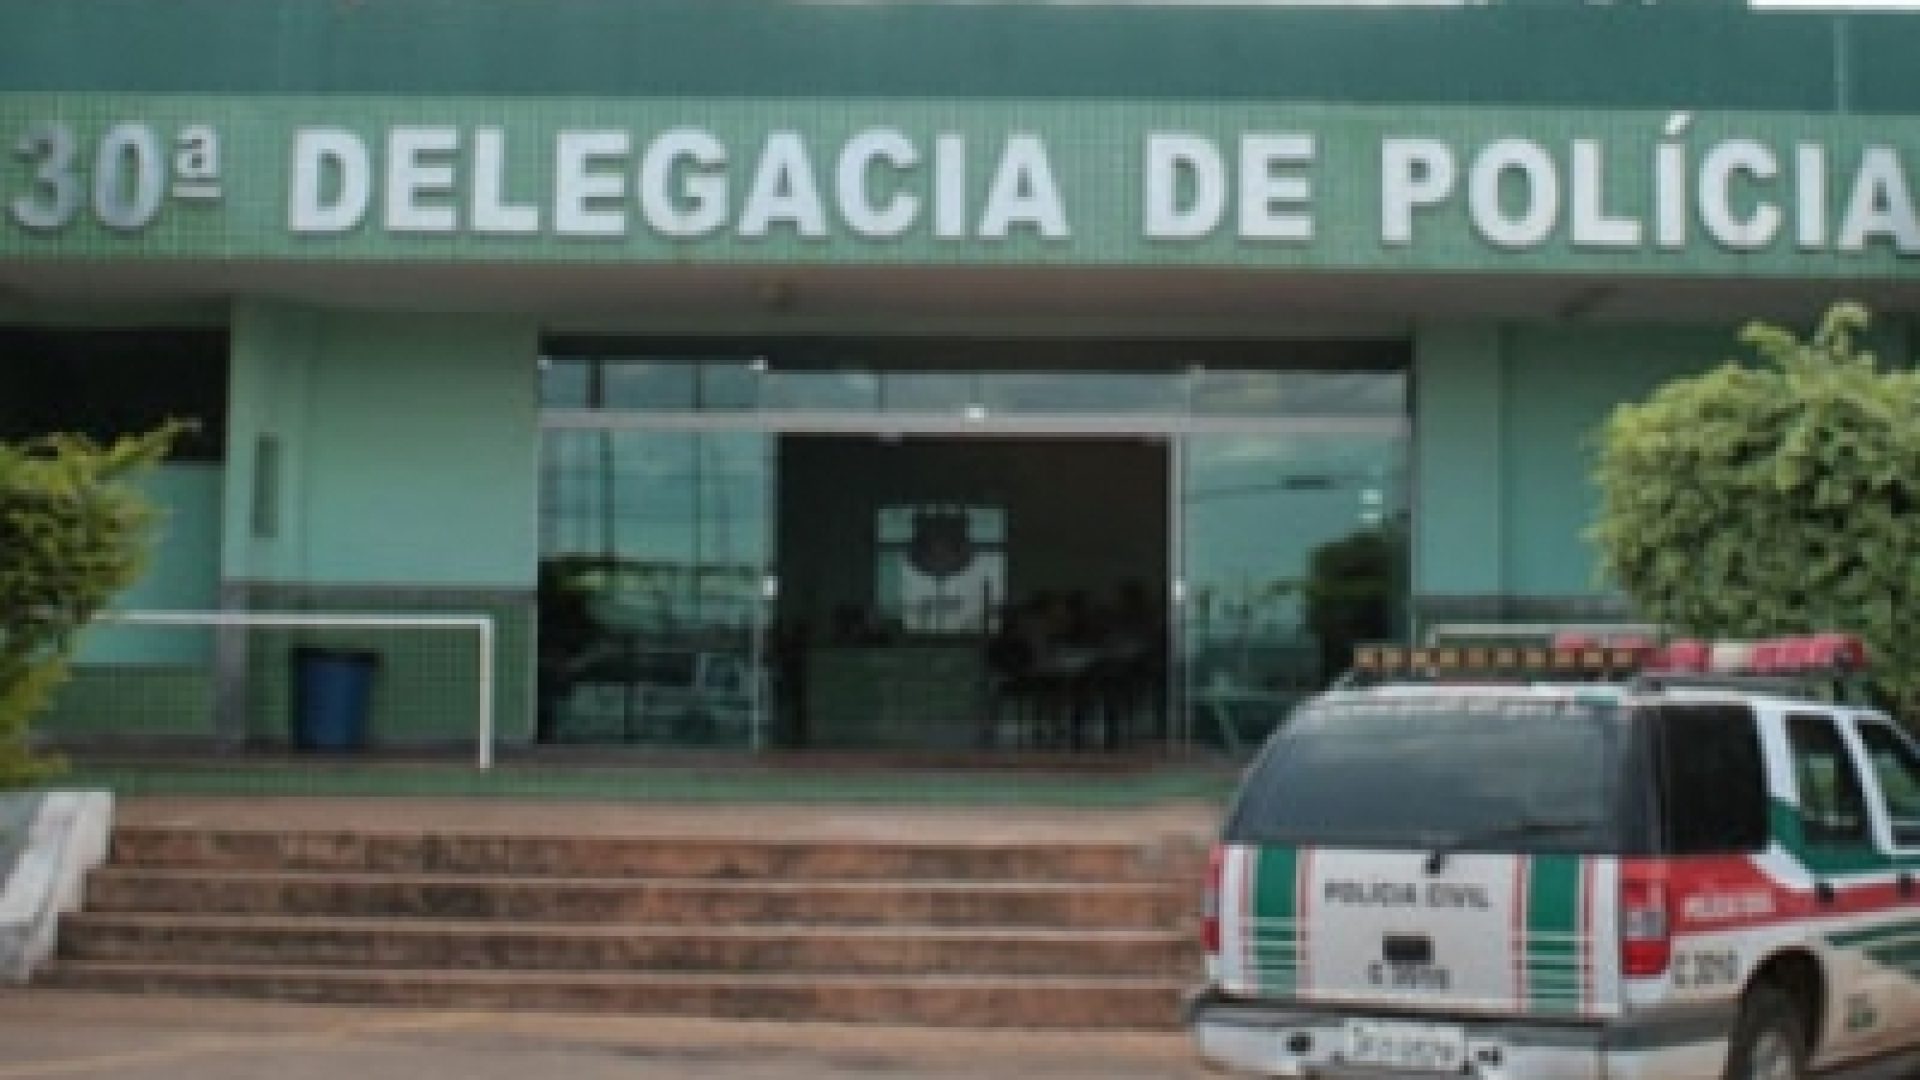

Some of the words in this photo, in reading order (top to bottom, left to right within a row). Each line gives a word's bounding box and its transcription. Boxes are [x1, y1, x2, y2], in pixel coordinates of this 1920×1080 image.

[10, 122, 222, 232] 30ª
[289, 125, 1070, 240] DELEGACIA
[1144, 131, 1315, 242] DE
[1380, 112, 1919, 251] POLÍCIA
